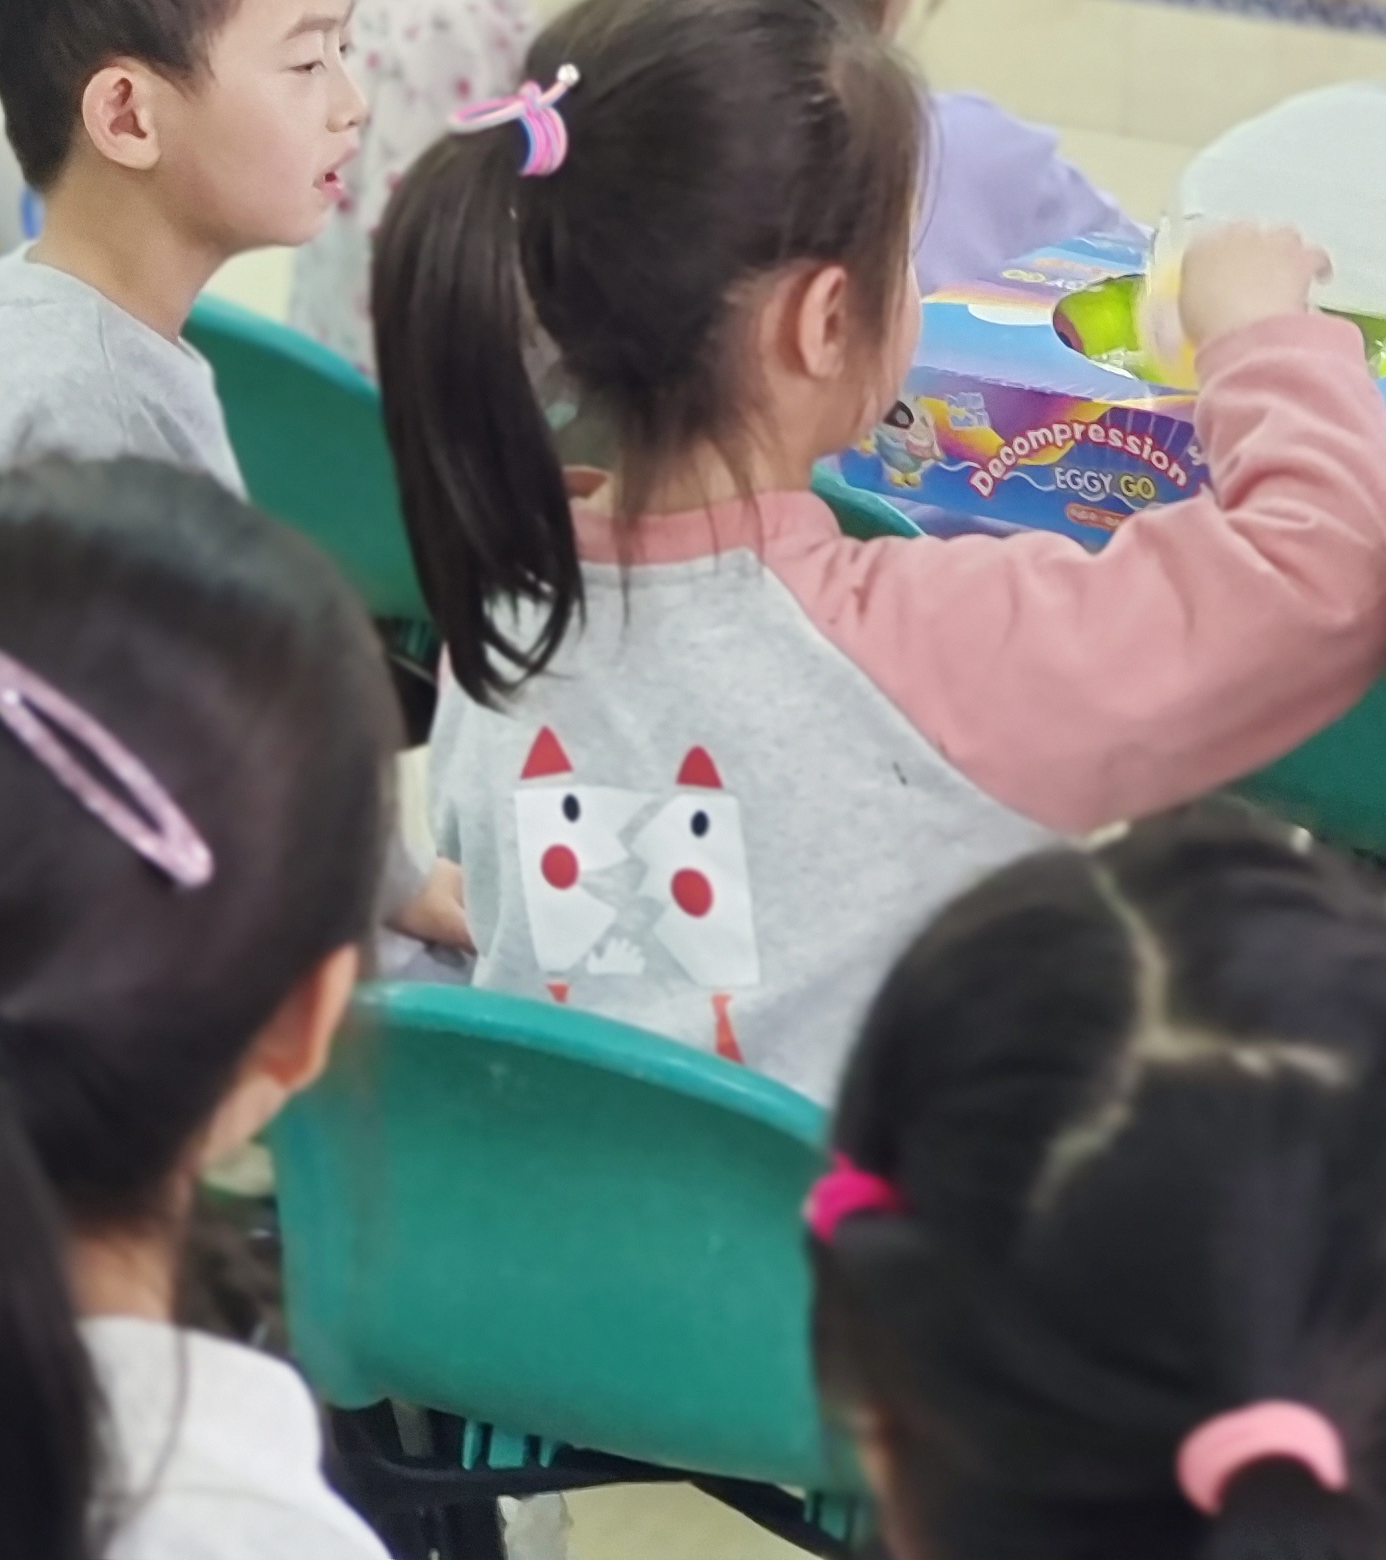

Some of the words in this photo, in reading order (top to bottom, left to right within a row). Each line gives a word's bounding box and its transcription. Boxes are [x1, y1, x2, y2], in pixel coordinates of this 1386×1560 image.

[969, 421, 1188, 497] Decompression
[1054, 467, 1113, 493] EGGY
[1119, 475, 1156, 500] GO
